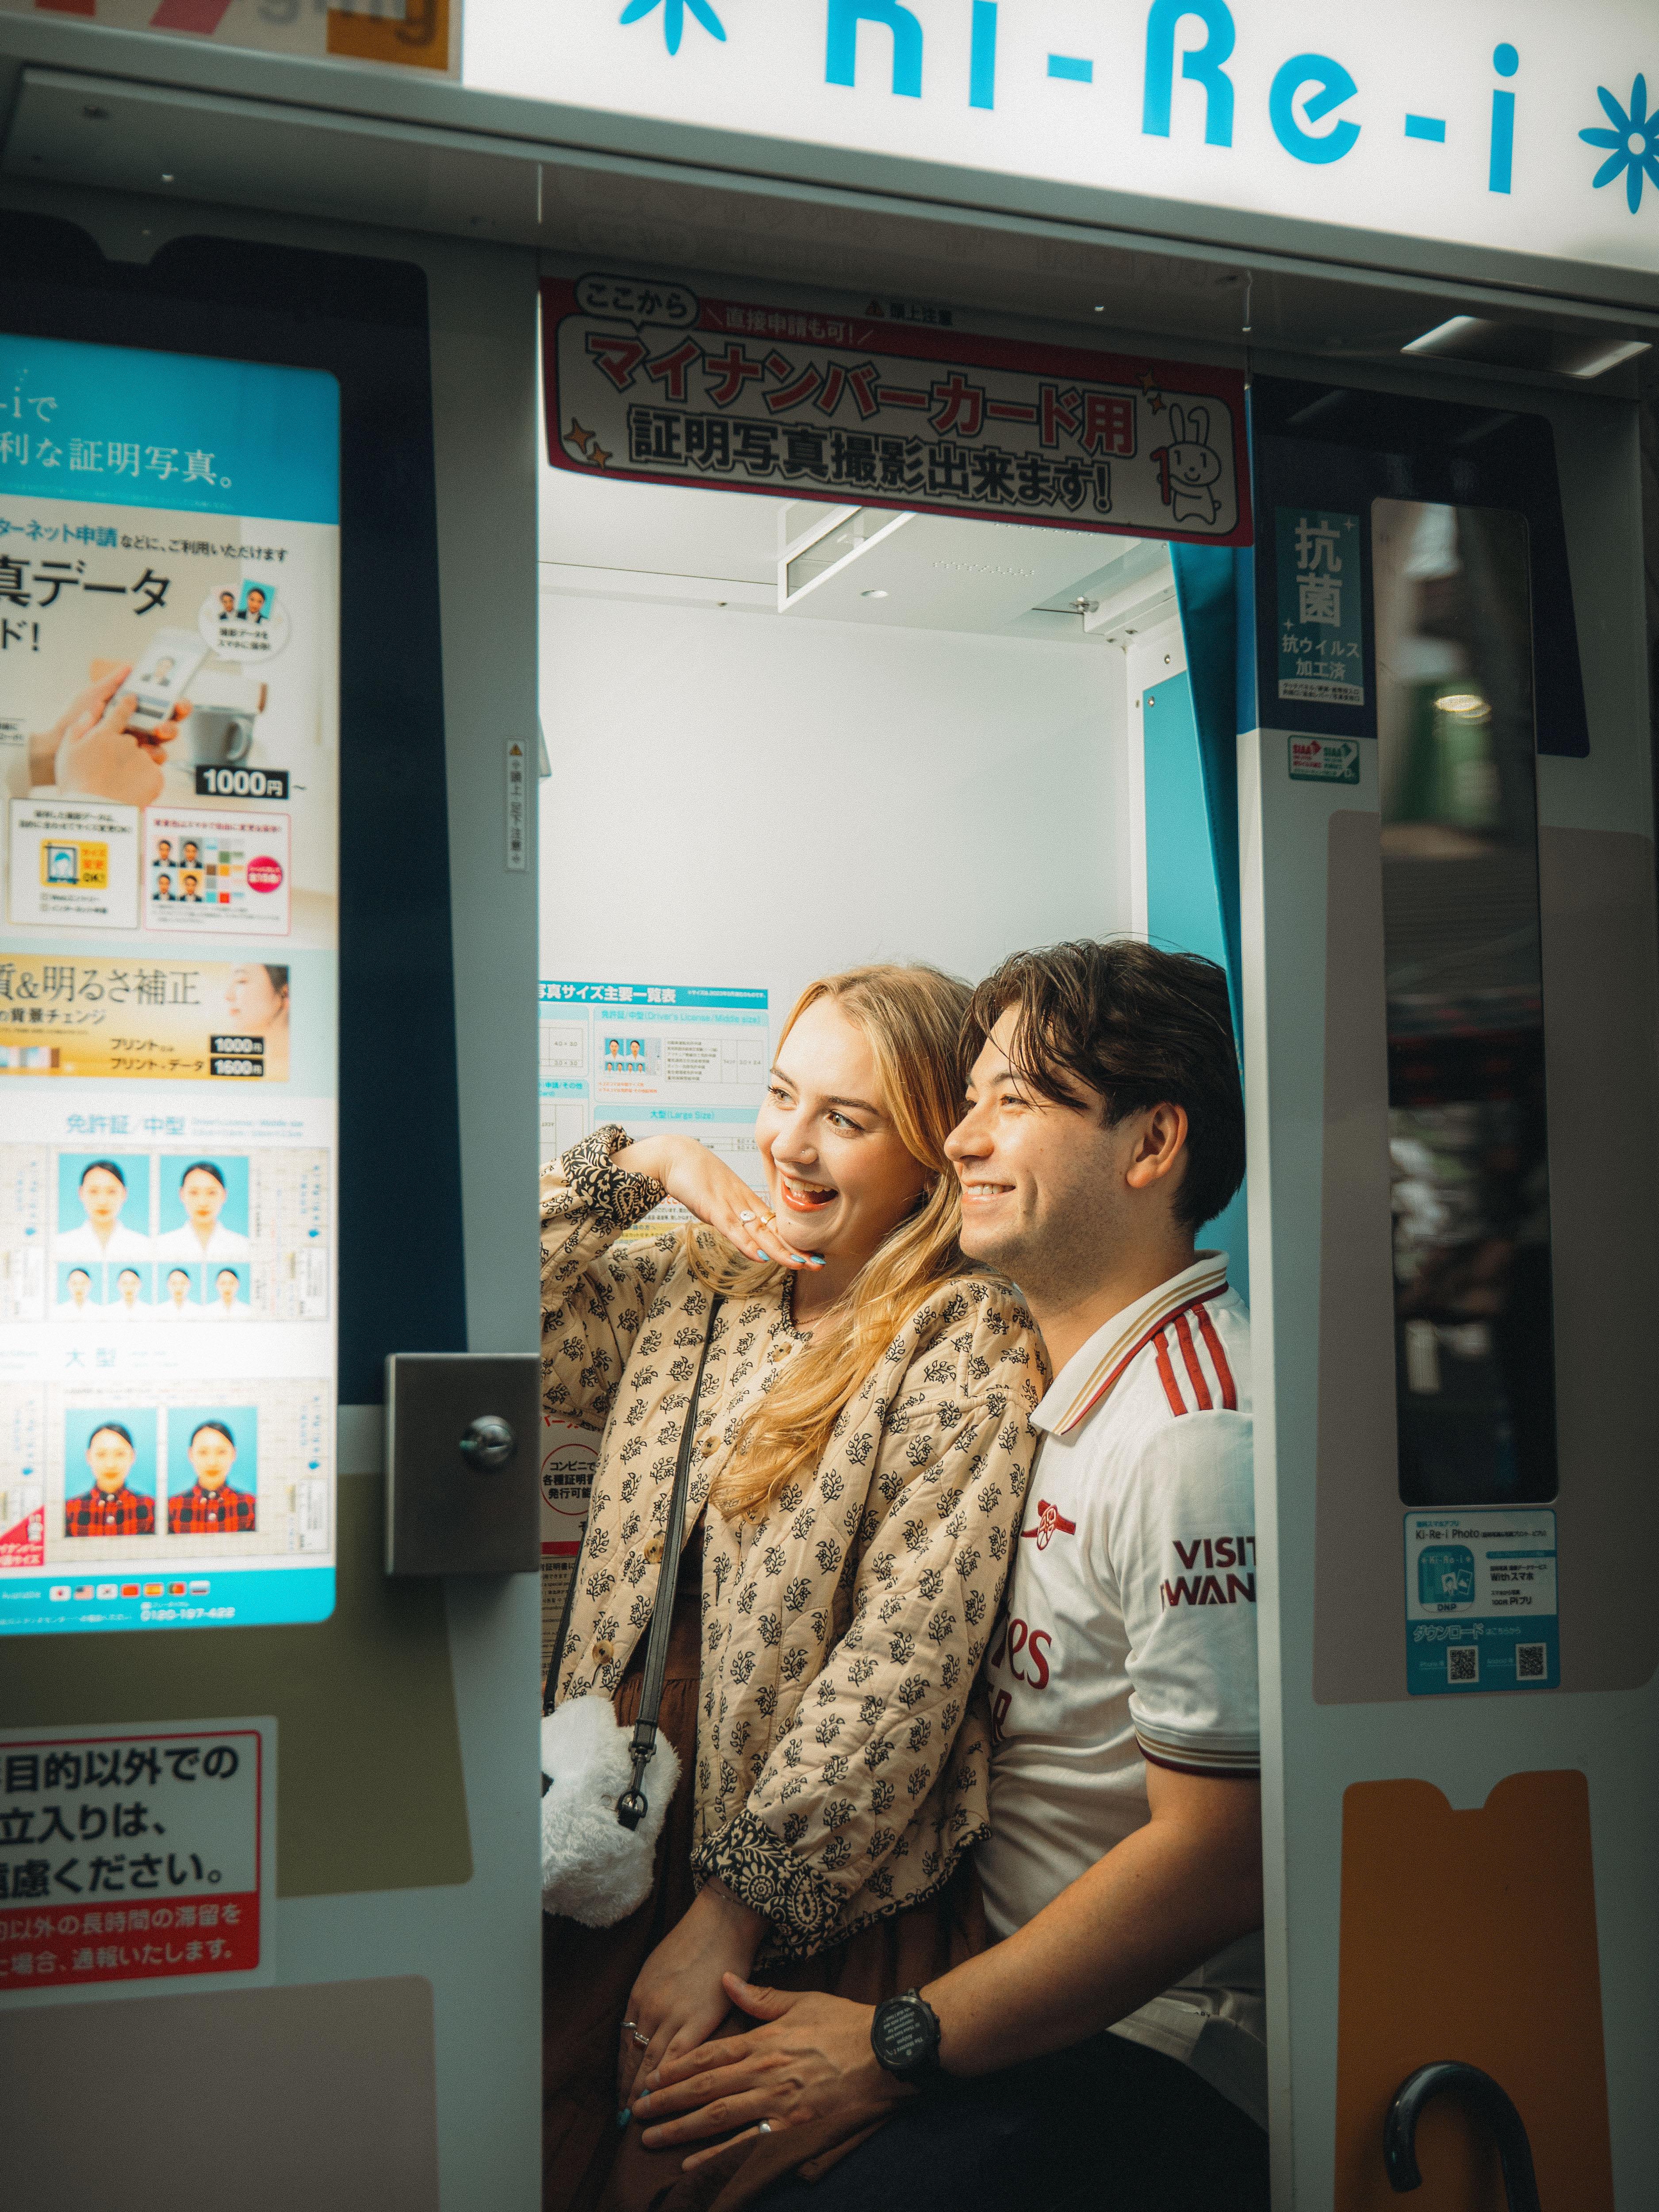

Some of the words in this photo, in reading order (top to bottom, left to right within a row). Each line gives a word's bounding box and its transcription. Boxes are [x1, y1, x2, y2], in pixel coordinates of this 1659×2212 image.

[586, 280, 690, 320] ここから
[724, 304, 858, 344] 直接申請も可!
[586, 328, 1138, 458] マイナンバーカード用
[628, 403, 1113, 514] 証明写真撮影出来ます!
[1294, 517, 1342, 627] 抗菌
[1282, 634, 1360, 658] 抗ウイルス
[1296, 658, 1346, 681] 加工済
[1416, 1530, 1448, 1539] Ki-Re-i
[1452, 1529, 1480, 1538] Photo
[1414, 1623, 1484, 1642] ダウンロード
[5, 1745, 240, 1794] 目的以外での
